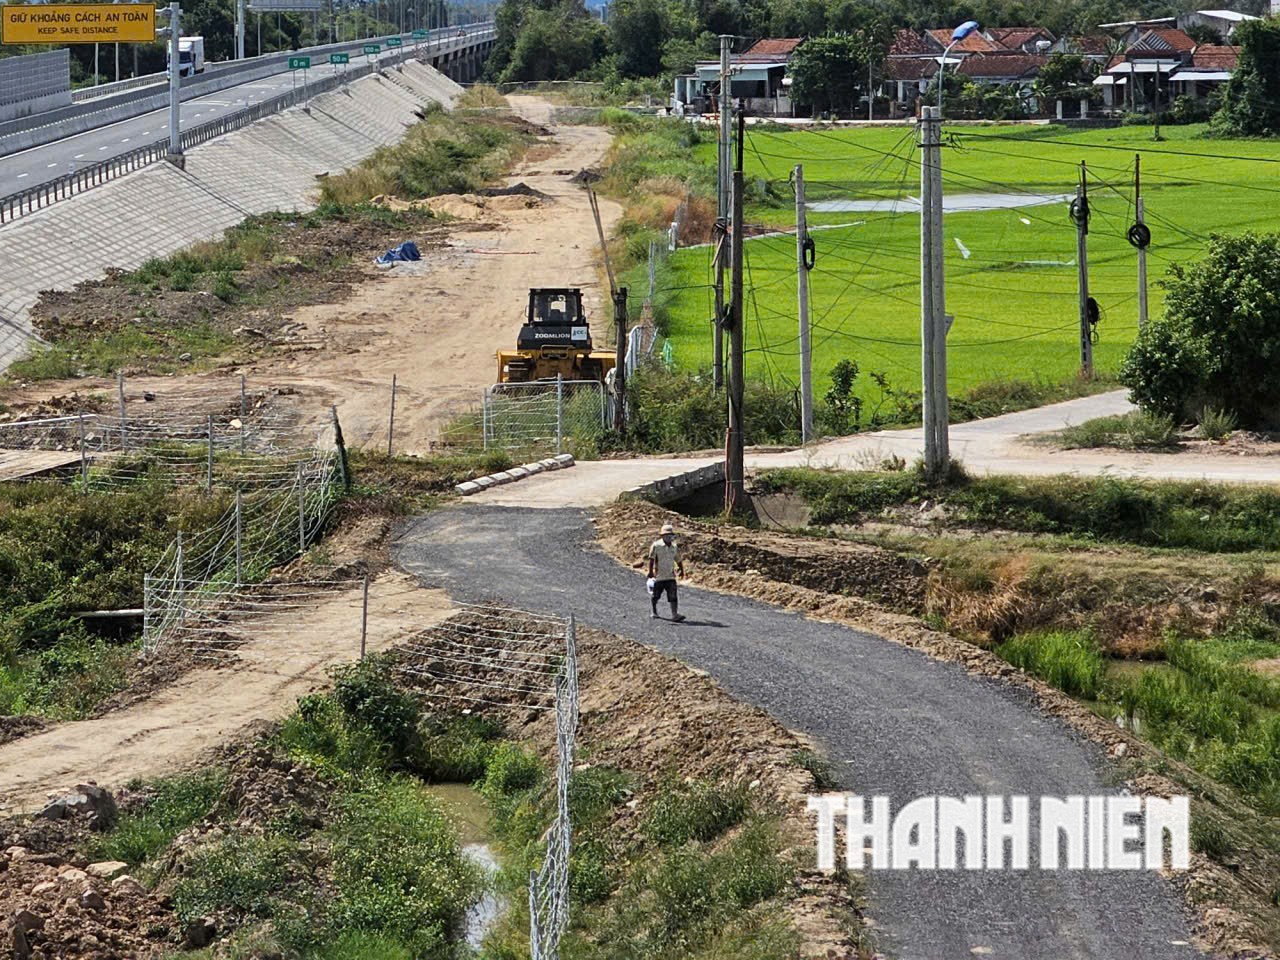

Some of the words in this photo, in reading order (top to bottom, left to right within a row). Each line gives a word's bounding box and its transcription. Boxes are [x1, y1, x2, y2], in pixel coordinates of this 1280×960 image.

[30, 10, 71, 23] KHOẢNG
[74, 11, 101, 23] CÁCH
[105, 12, 120, 22] AN
[122, 10, 148, 22] TOÀN
[37, 26, 58, 34] KEEP
[60, 26, 80, 34] SAFE
[82, 26, 118, 34] DISTANCE
[293, 59, 299, 67] 0
